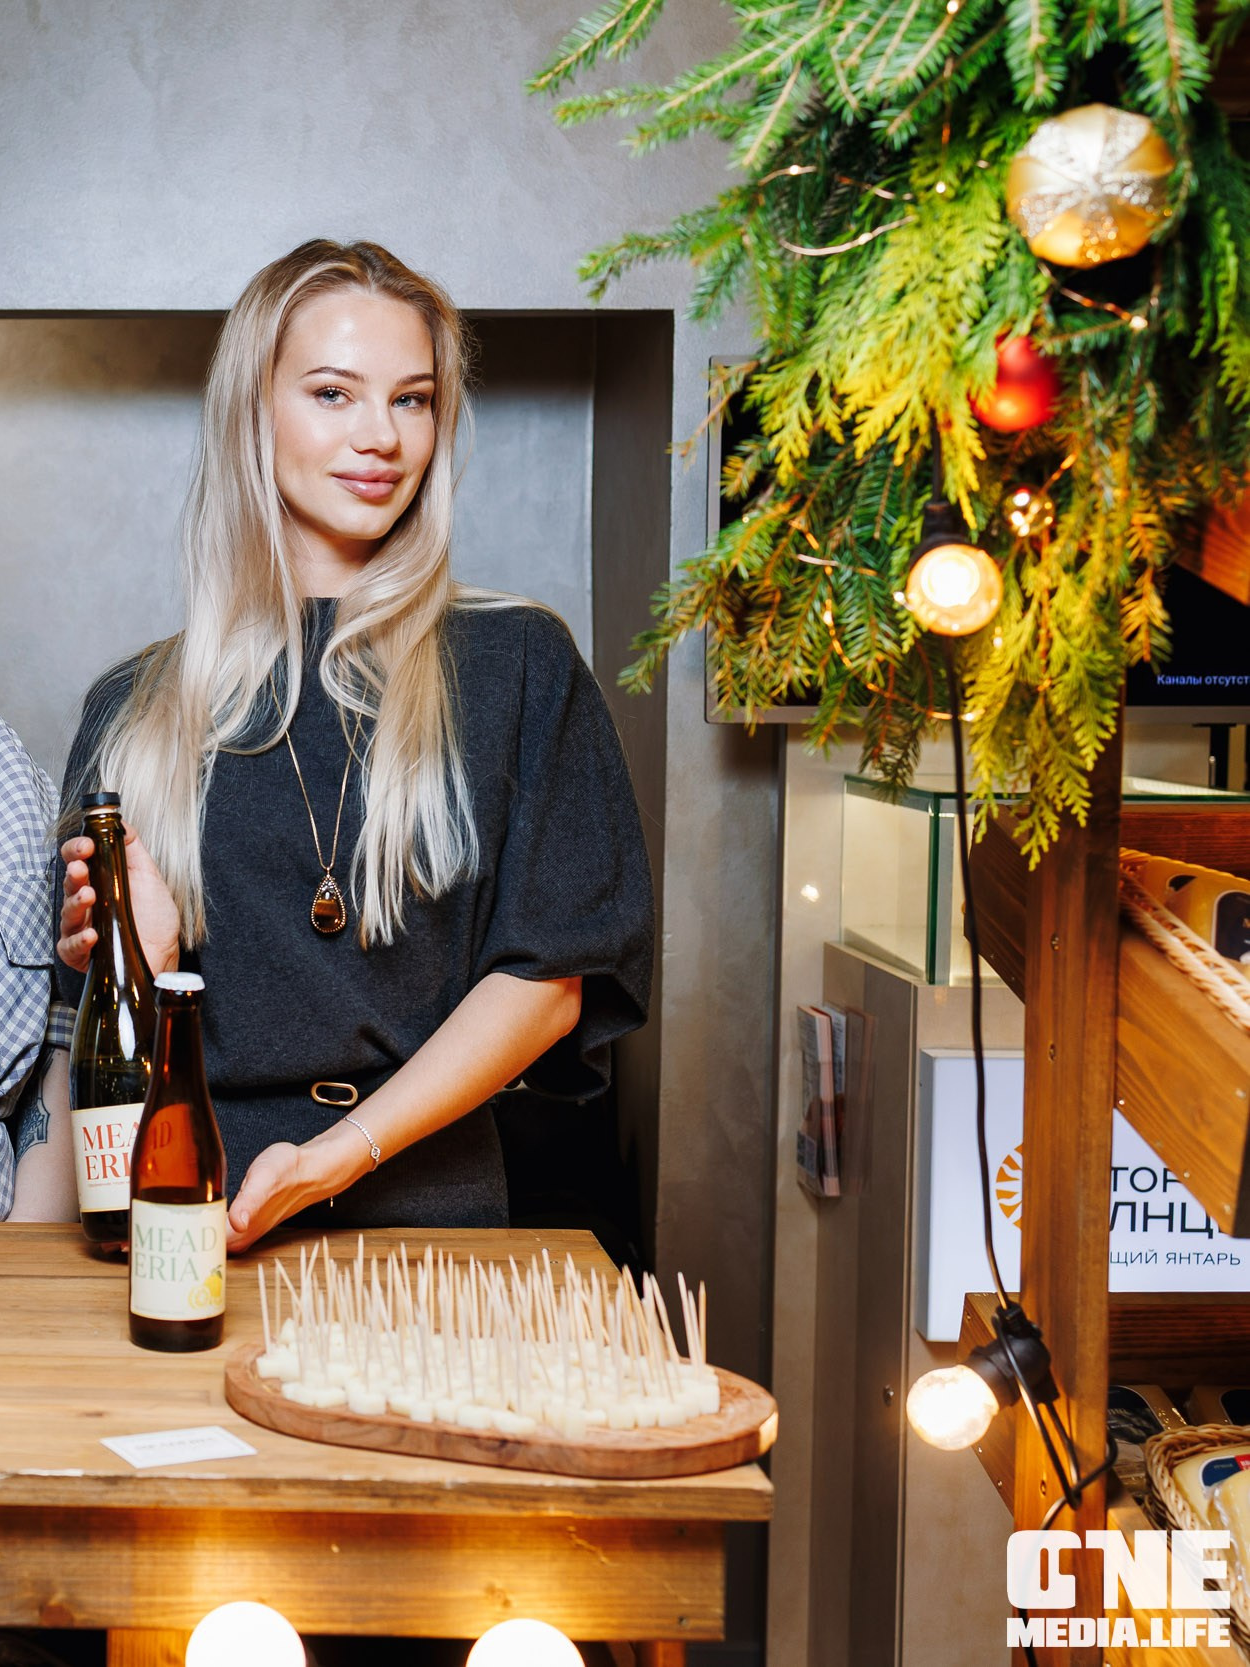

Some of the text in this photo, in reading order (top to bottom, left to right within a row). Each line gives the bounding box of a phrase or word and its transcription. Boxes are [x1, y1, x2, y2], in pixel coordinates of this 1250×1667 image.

[1157, 674, 1202, 685] Каналы
[134, 1223, 218, 1254] MEAD
[134, 1251, 200, 1282] ERIA
[1166, 1252, 1241, 1266] ЯНТАРЬ
